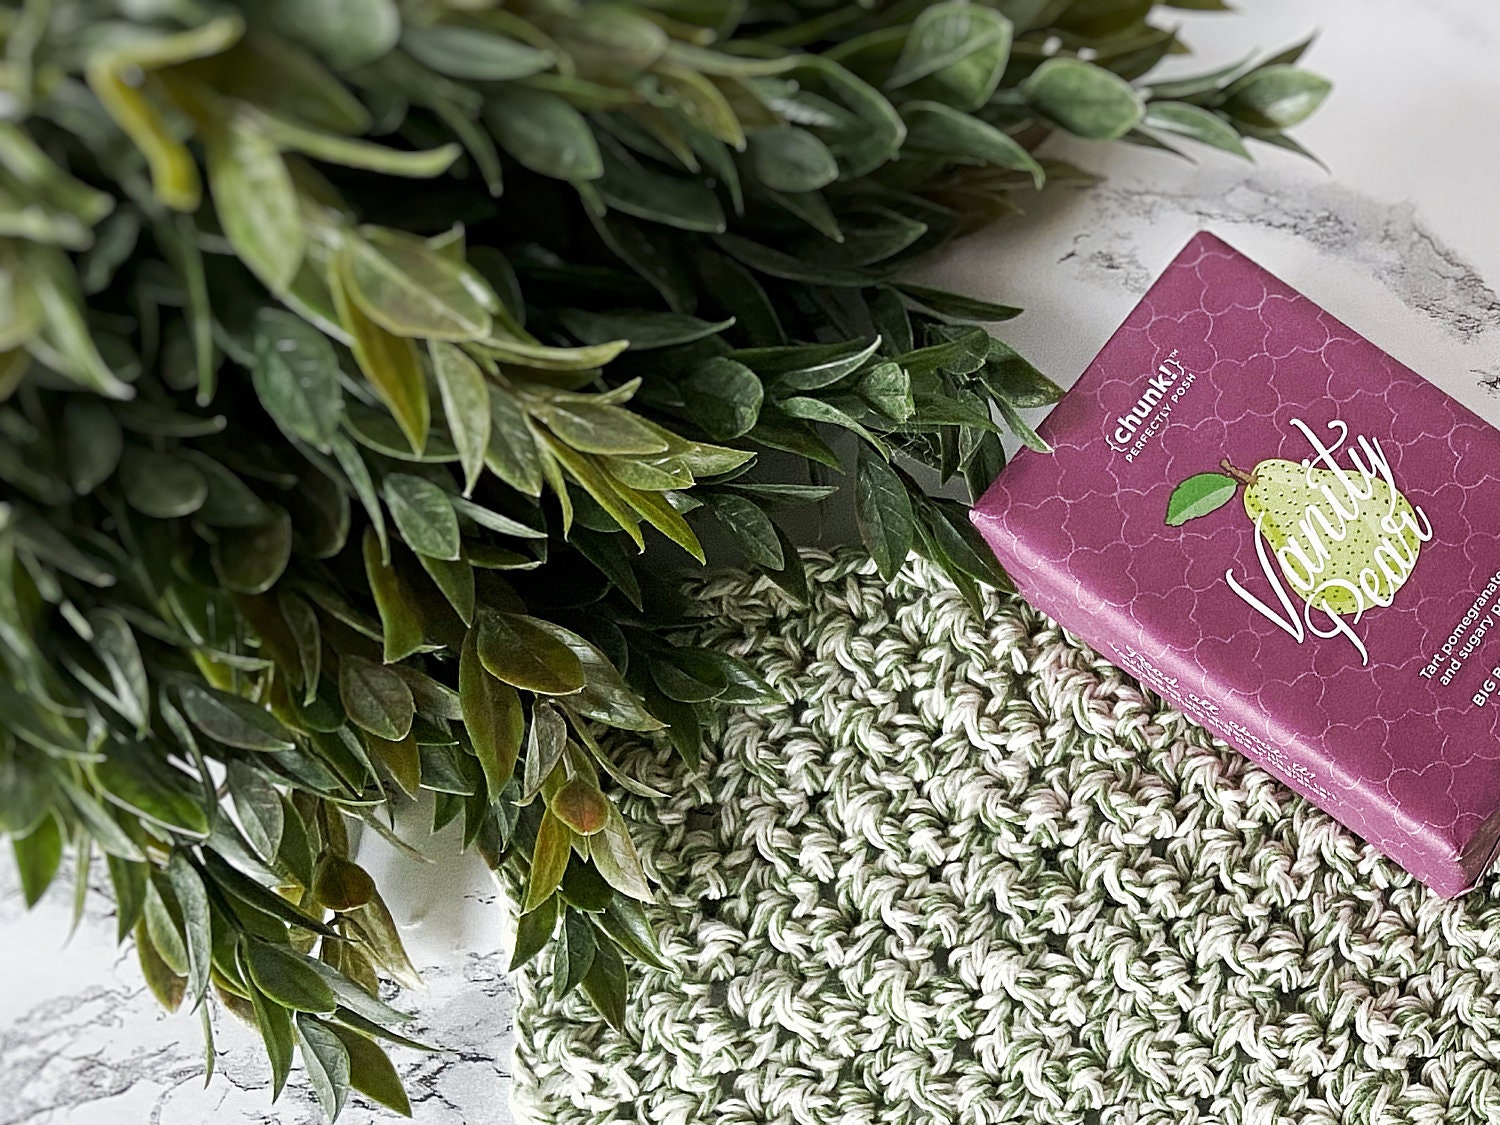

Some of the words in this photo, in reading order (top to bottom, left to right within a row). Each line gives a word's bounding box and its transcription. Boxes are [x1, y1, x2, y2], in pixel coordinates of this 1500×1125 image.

[1125, 403, 1172, 463] PERFECTLY
[1171, 373, 1196, 403] POSH
[1225, 418, 1397, 643] Vanity
[1304, 505, 1433, 666] Pear
[1126, 645, 1180, 689] Read
[1188, 693, 1219, 715] all
[1419, 653, 1445, 679] Tart
[1439, 658, 1462, 686] and
[1458, 615, 1494, 660] sugary
[1472, 679, 1496, 707] BIG
